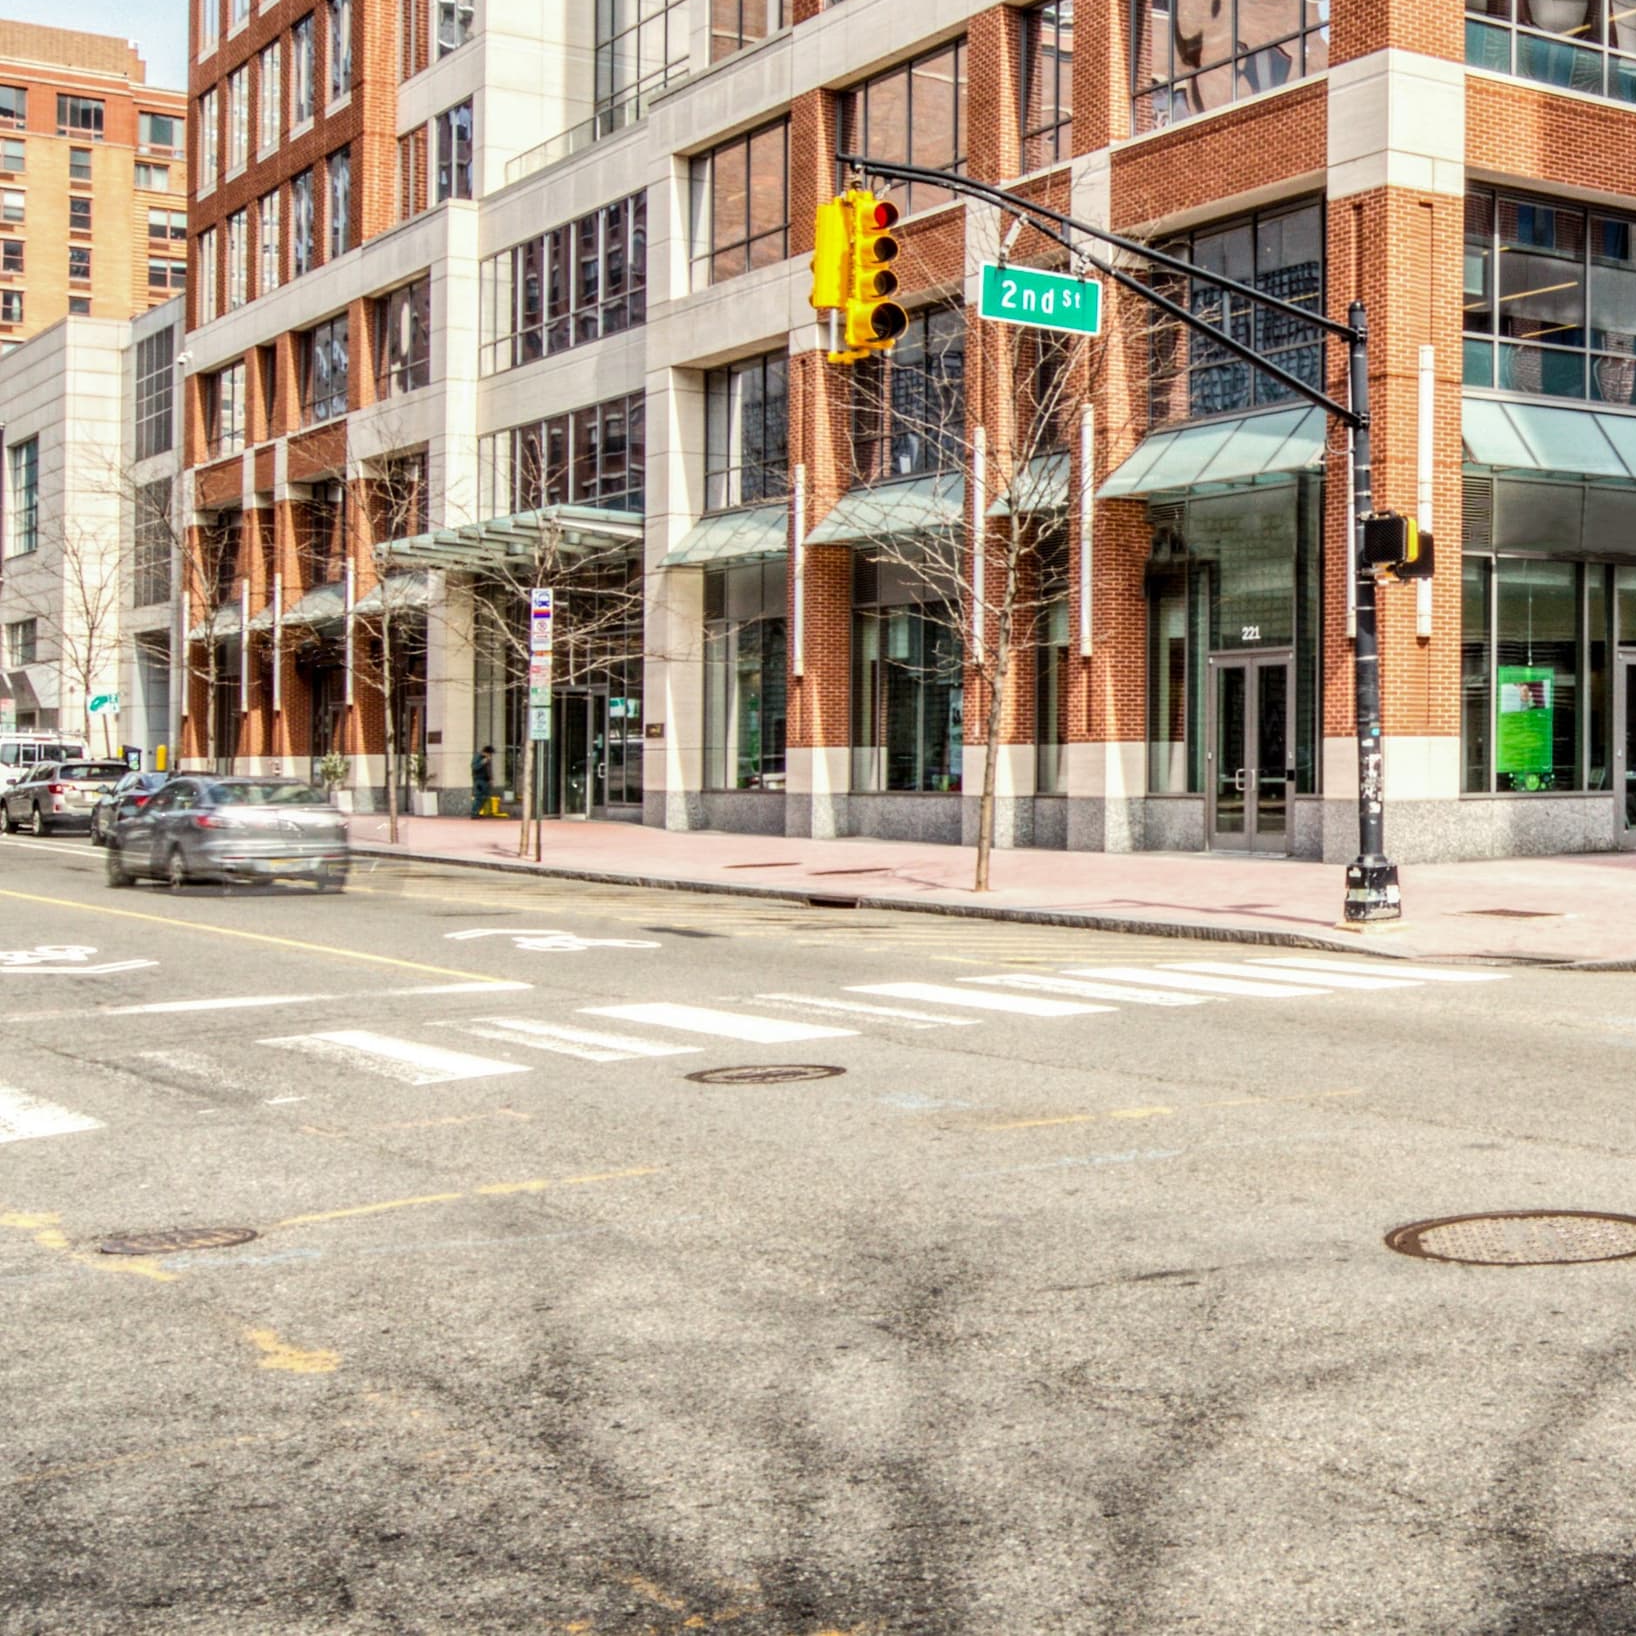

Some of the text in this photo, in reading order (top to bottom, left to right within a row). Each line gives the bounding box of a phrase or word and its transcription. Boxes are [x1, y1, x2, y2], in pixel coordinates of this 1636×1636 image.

[1001, 279, 1081, 314] 2nd St
[1242, 625, 1261, 640] 221
